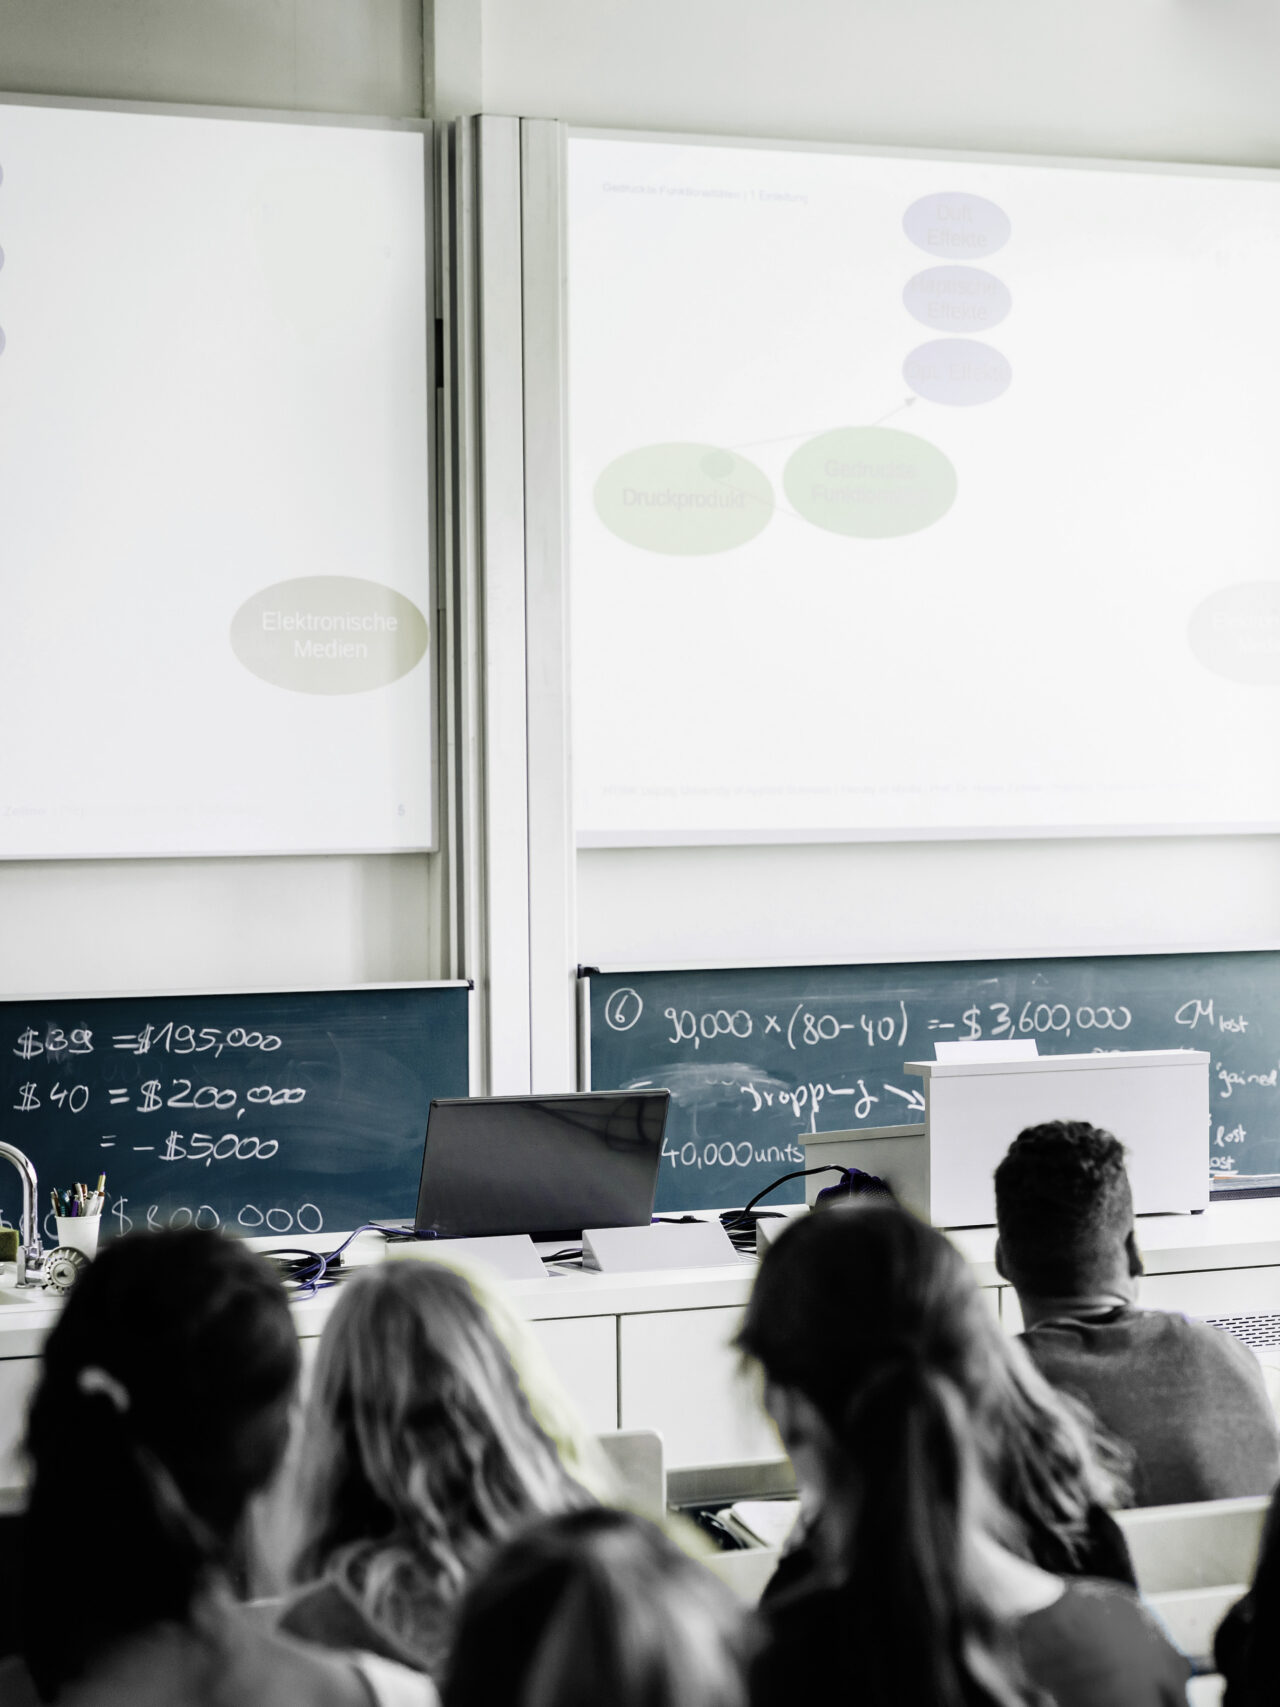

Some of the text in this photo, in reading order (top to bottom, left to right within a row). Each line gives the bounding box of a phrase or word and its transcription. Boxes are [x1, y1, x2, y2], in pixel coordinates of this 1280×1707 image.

[926, 227, 987, 249] Effekte
[622, 486, 745, 511] Druckprodukt
[261, 610, 398, 632] Elektronische
[294, 639, 369, 660] Medien
[1219, 1014, 1249, 1033] lost
[1214, 1123, 1247, 1147] lost
